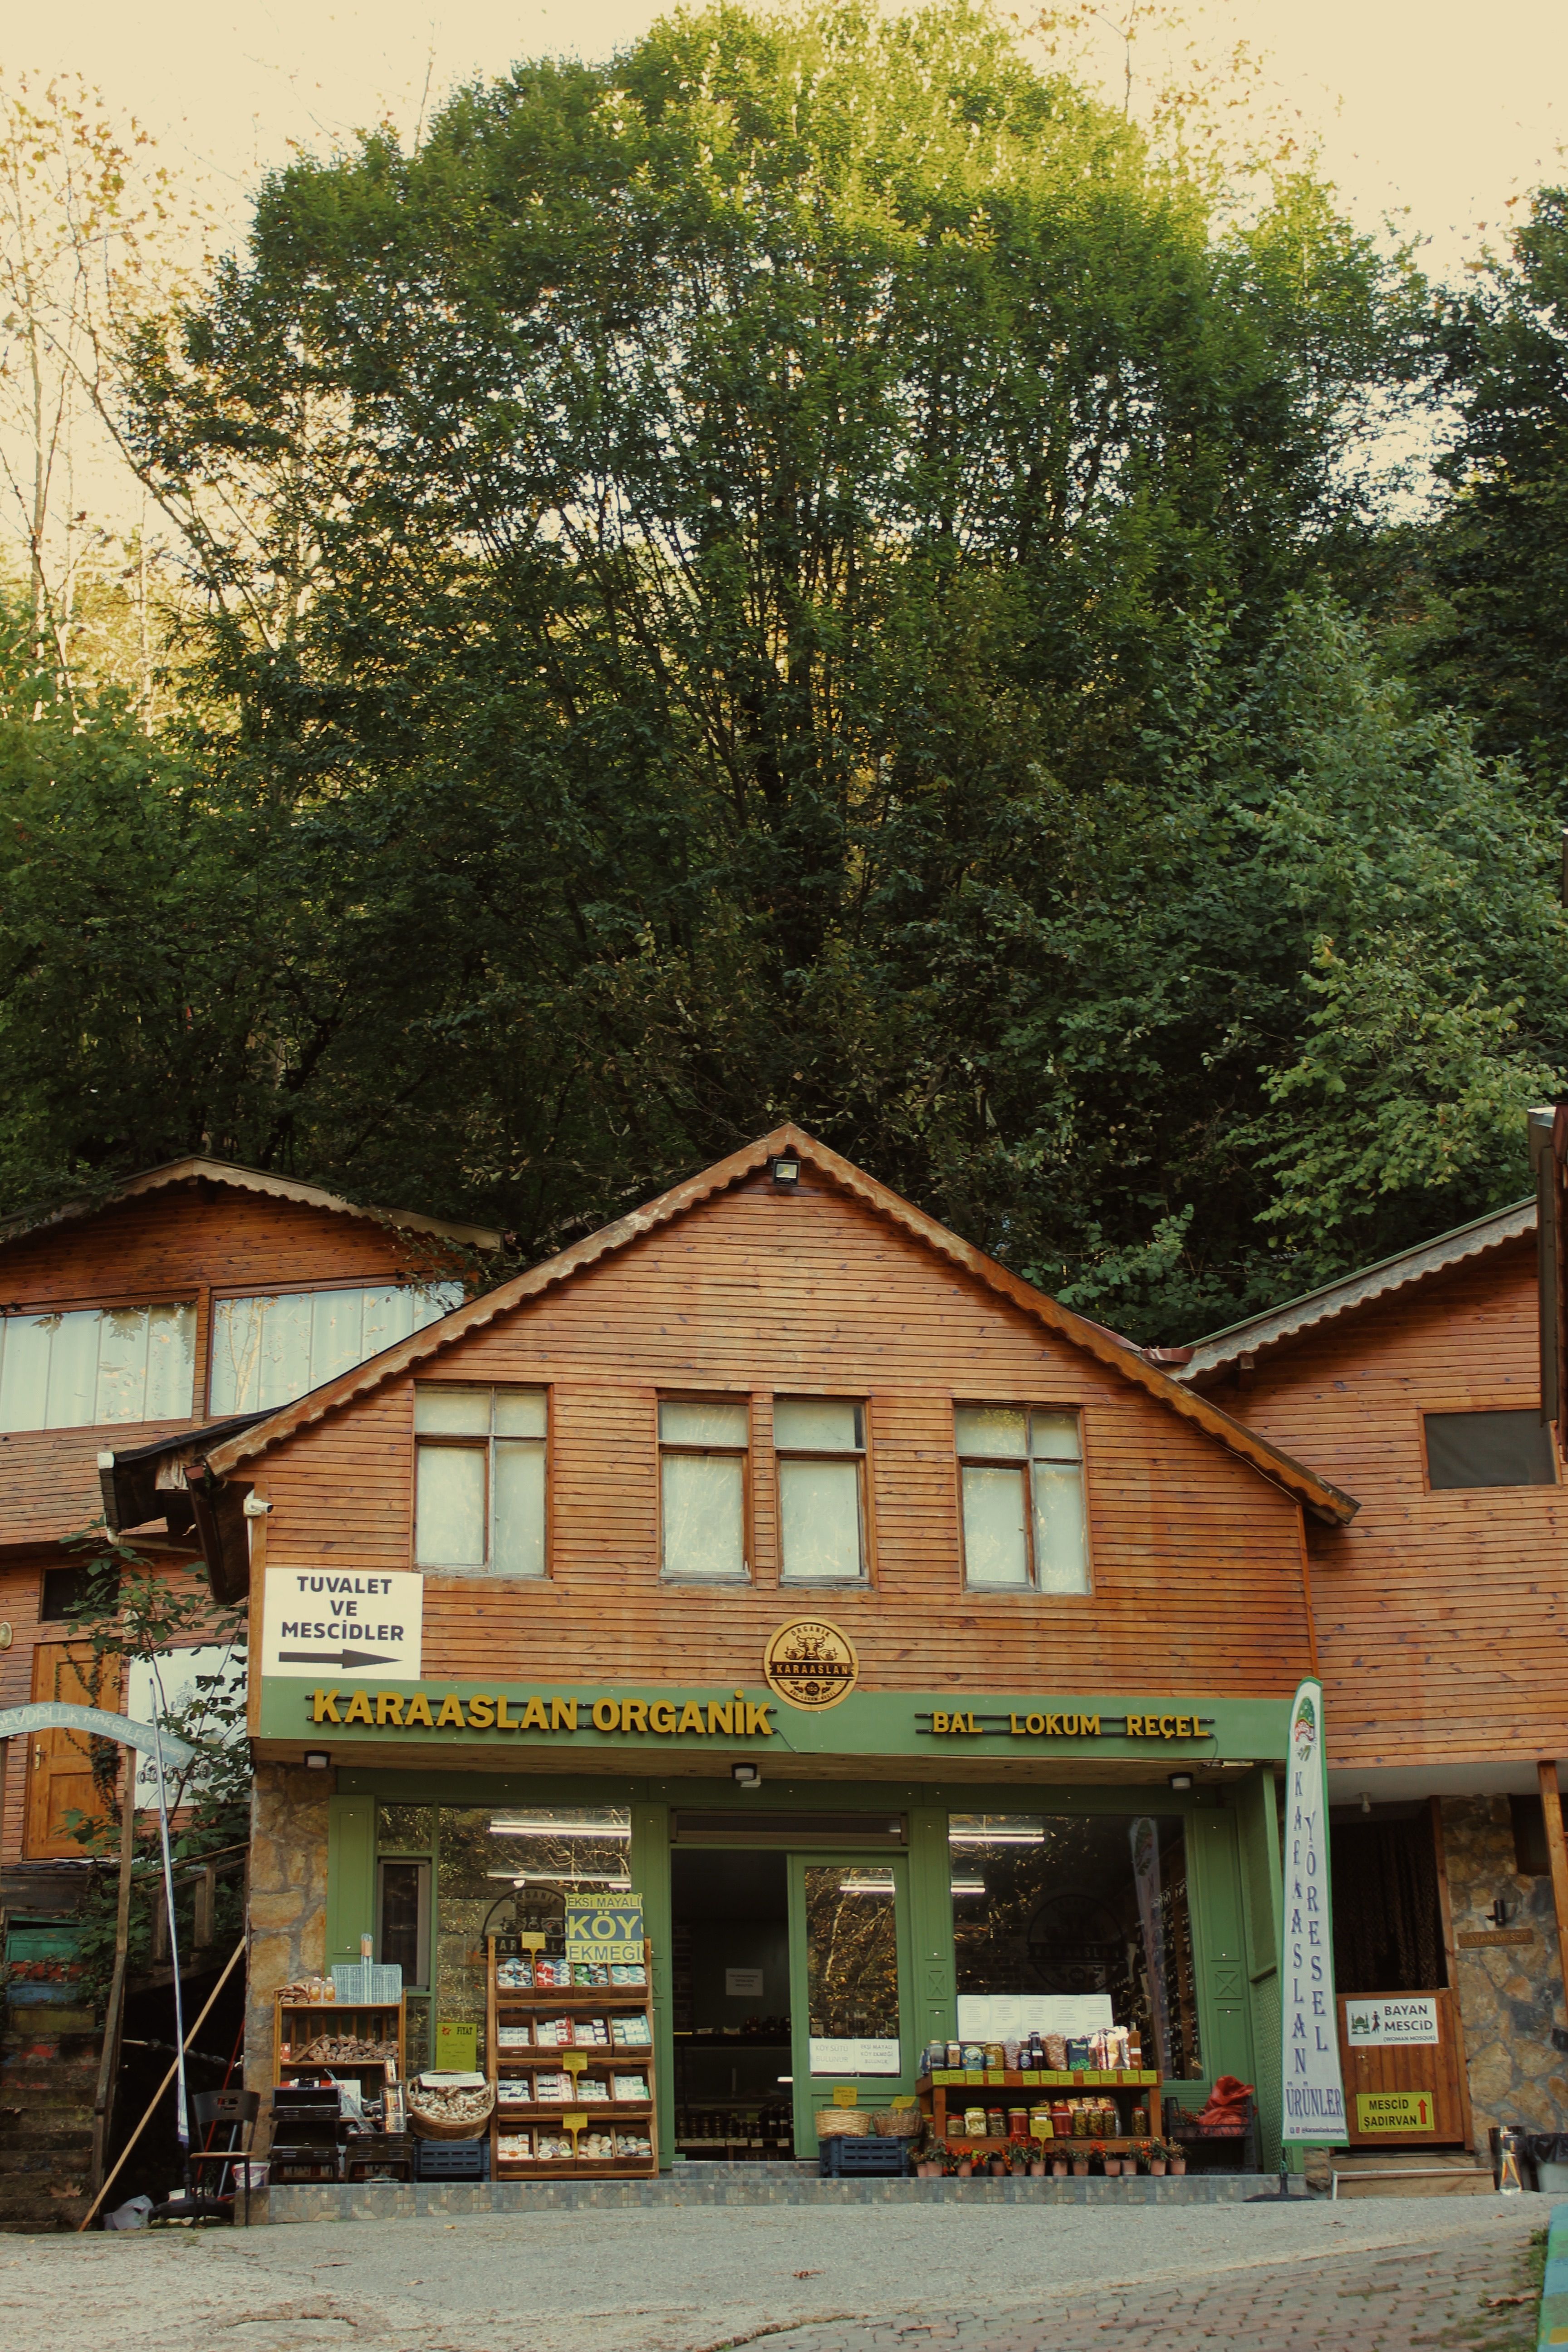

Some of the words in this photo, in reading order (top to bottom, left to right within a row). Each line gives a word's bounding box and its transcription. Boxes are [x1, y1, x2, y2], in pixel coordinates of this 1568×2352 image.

[297, 1576, 392, 1595] TUVALET
[330, 1600, 358, 1617] VE
[281, 1619, 404, 1641] MESCİDLER
[791, 1626, 831, 1638] ORGANİK
[776, 1665, 848, 1675] KARAASLAN
[313, 1689, 578, 1730] KARAASLAN
[592, 1689, 773, 1735] ORGANİK
[932, 1711, 983, 1733] BAL
[1009, 1713, 1102, 1736] LOKUM
[1126, 1715, 1210, 1739] REÇEL
[597, 1897, 640, 1907] MAYALI
[568, 1910, 639, 1939] KÖY
[1303, 1811, 1328, 2052] YÖRESEL
[1462, 1934, 1494, 1944] BAYAN
[569, 1941, 640, 1960] EKMEĞİ
[1384, 2004, 1428, 2016] BAYAN
[1286, 2081, 1343, 2118] ÜRÜNLER
[1369, 2097, 1409, 2110] MESCİD
[1364, 2115, 1417, 2129] ŞADIRVAN
